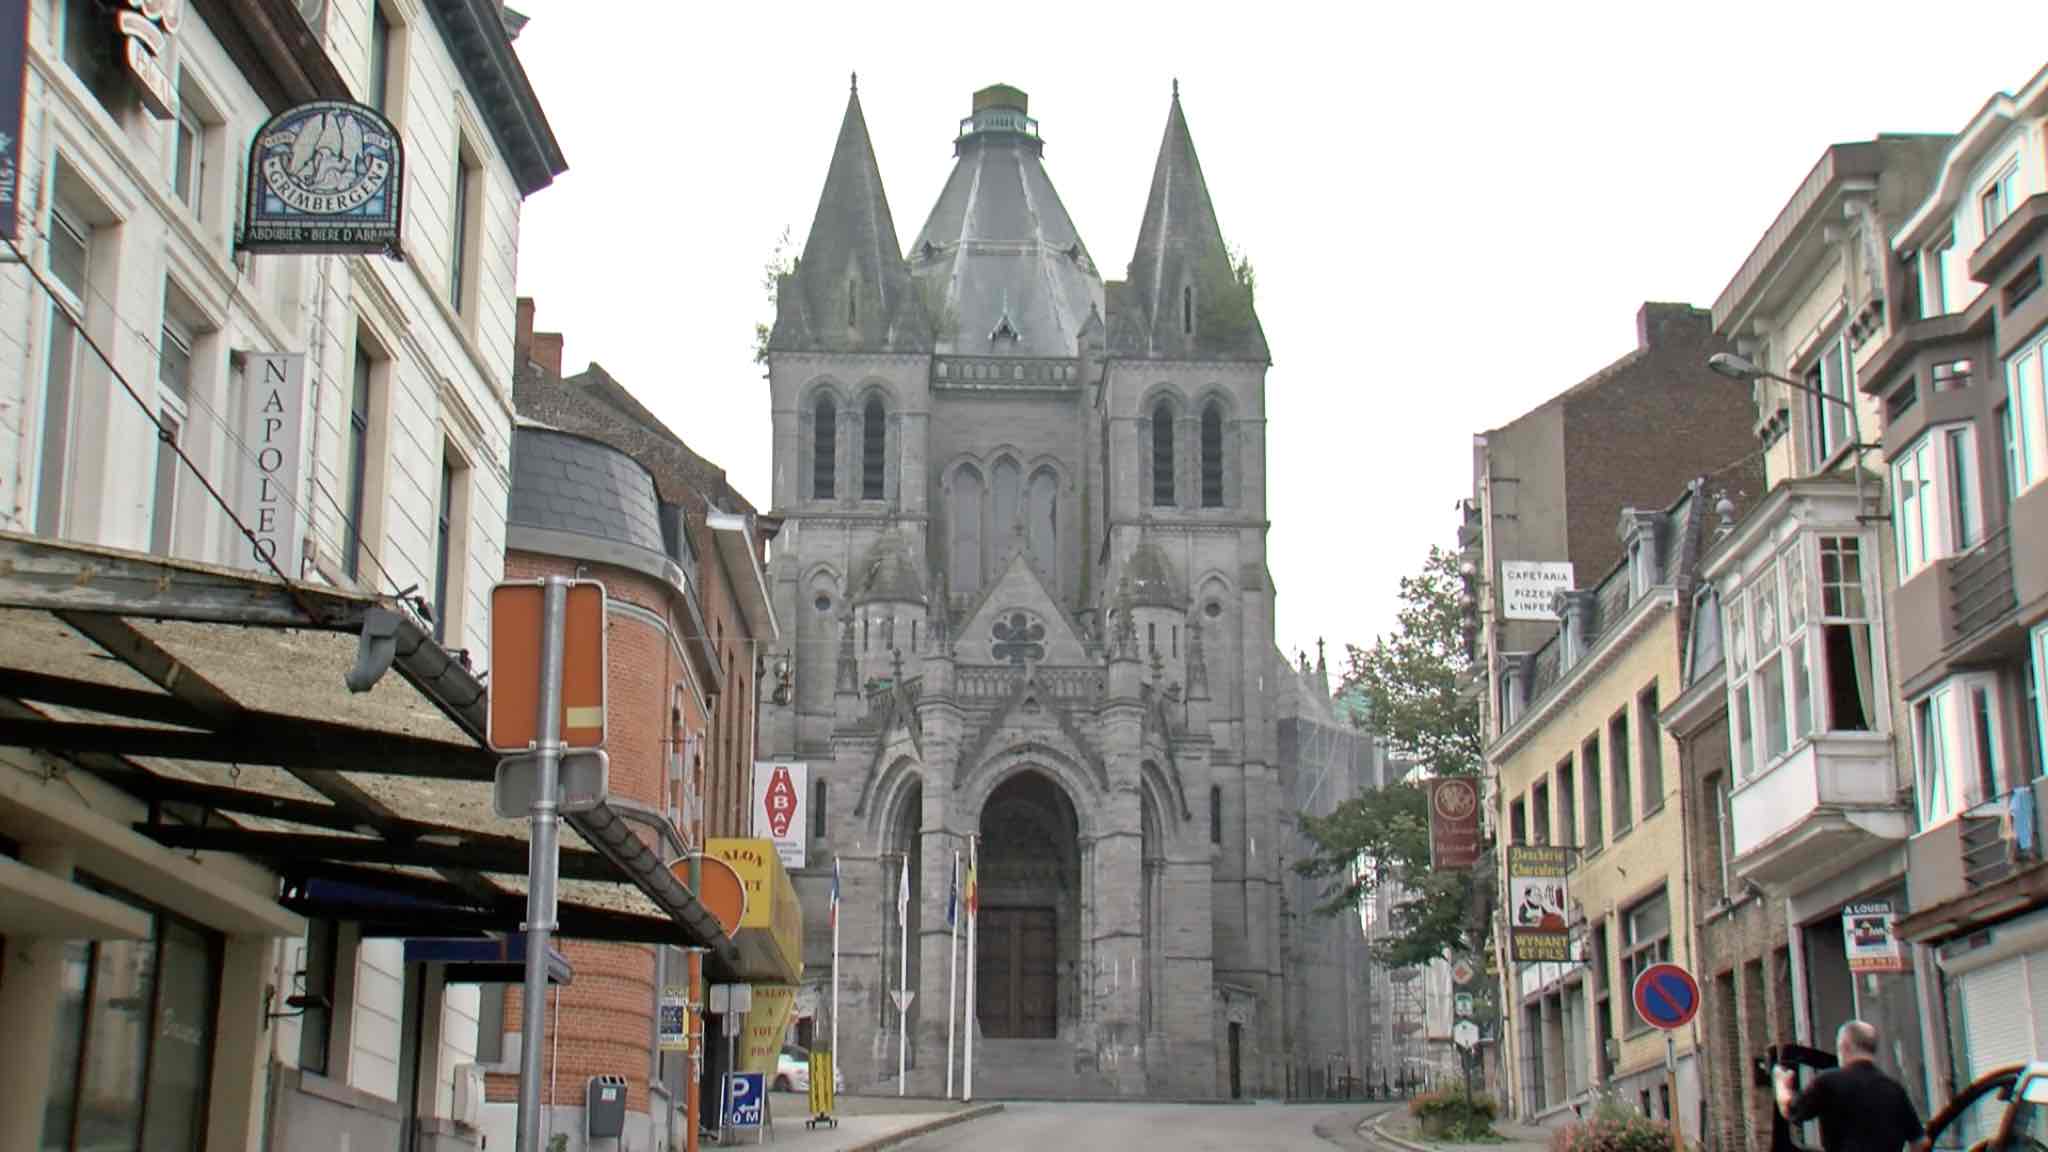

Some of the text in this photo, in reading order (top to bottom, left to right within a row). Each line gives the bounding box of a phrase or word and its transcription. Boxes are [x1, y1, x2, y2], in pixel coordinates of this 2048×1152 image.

[268, 170, 384, 211] GRIMBERGEN
[251, 358, 289, 578] NAPOLEO
[773, 768, 789, 837] TABAC
[1854, 903, 1889, 913] LOUER
[1515, 935, 1568, 945] WYNANT
[1519, 946, 1565, 959] ET FILS
[732, 1077, 751, 1097] P
